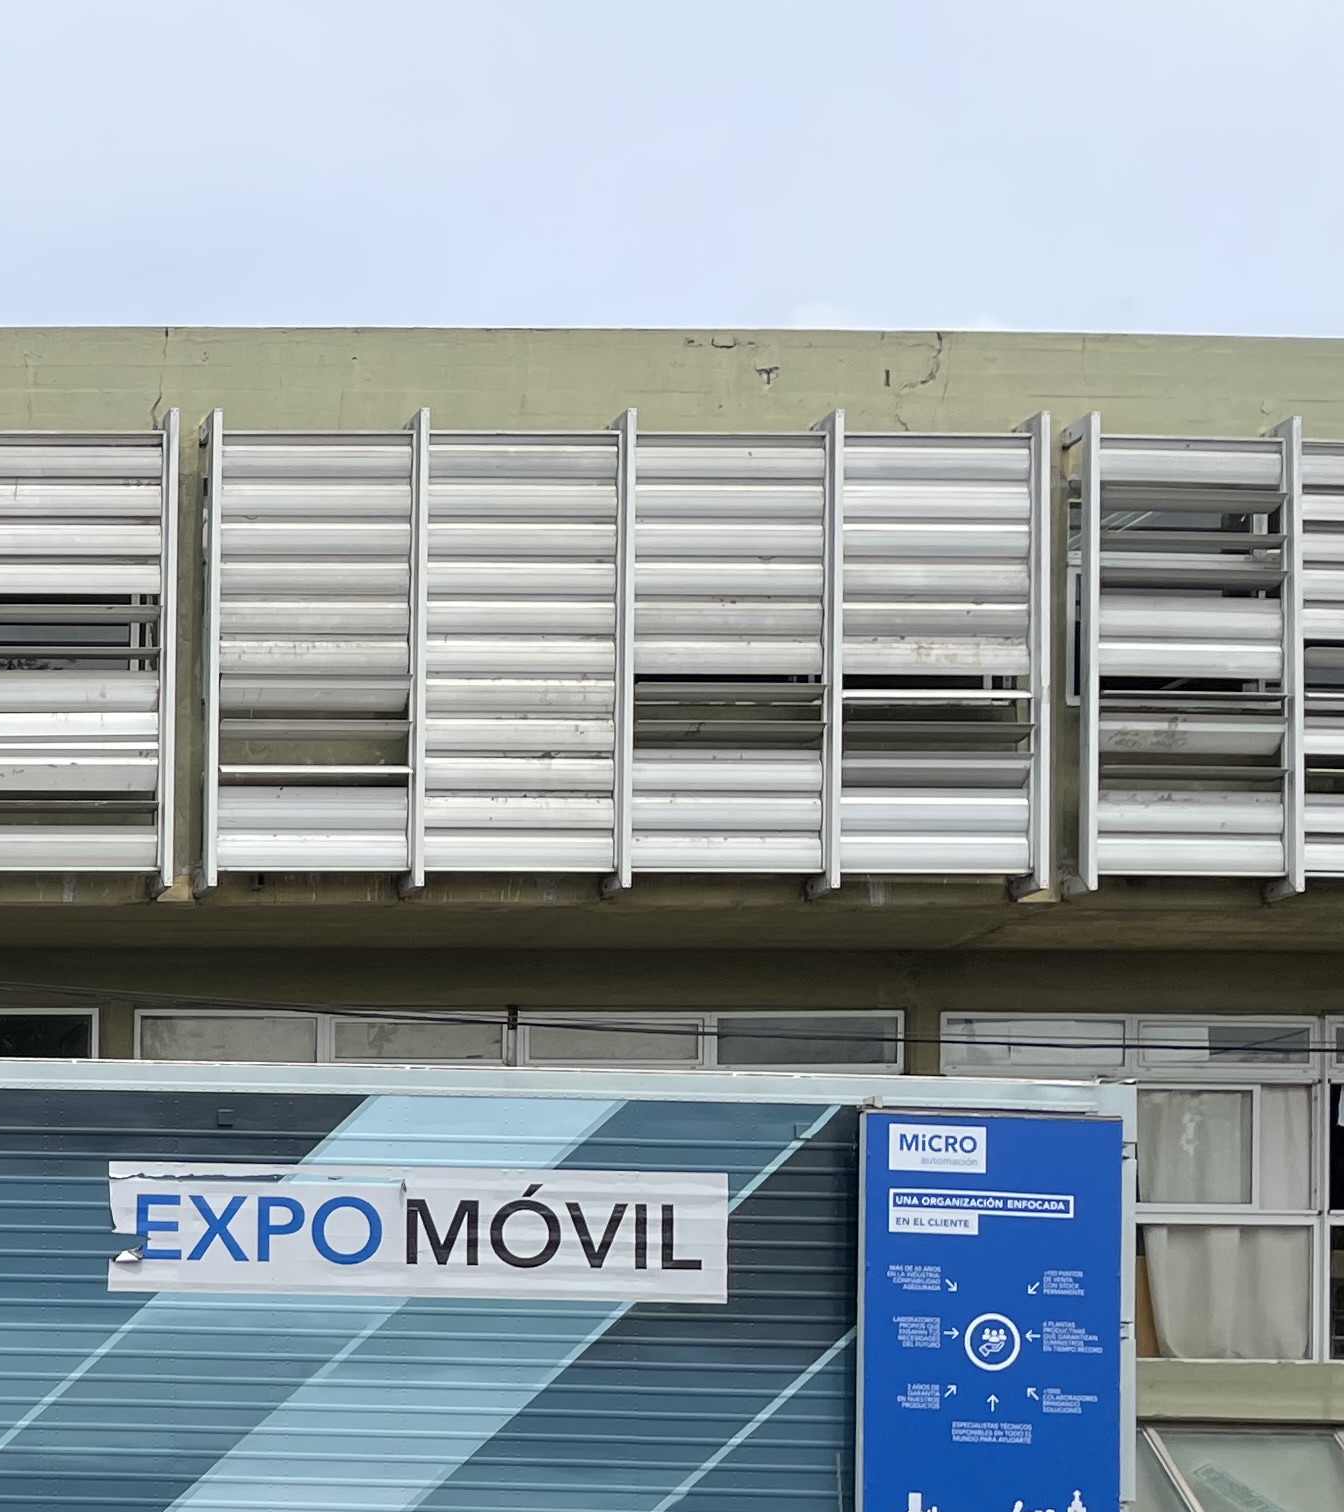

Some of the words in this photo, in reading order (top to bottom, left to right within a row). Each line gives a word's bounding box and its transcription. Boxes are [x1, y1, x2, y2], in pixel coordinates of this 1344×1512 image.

[899, 1133, 978, 1154] MiCRO
[920, 1155, 978, 1167] automación
[895, 1195, 919, 1206] UNA
[921, 1196, 1004, 1209] ORGANIZACIÓN
[1007, 1199, 1066, 1211] ENFOCADA
[134, 1192, 384, 1266] EXPO
[405, 1183, 704, 1272] MÓVIL
[895, 1216, 910, 1226] EN
[913, 1217, 925, 1227] EL
[927, 1218, 970, 1229] CLIENTE
